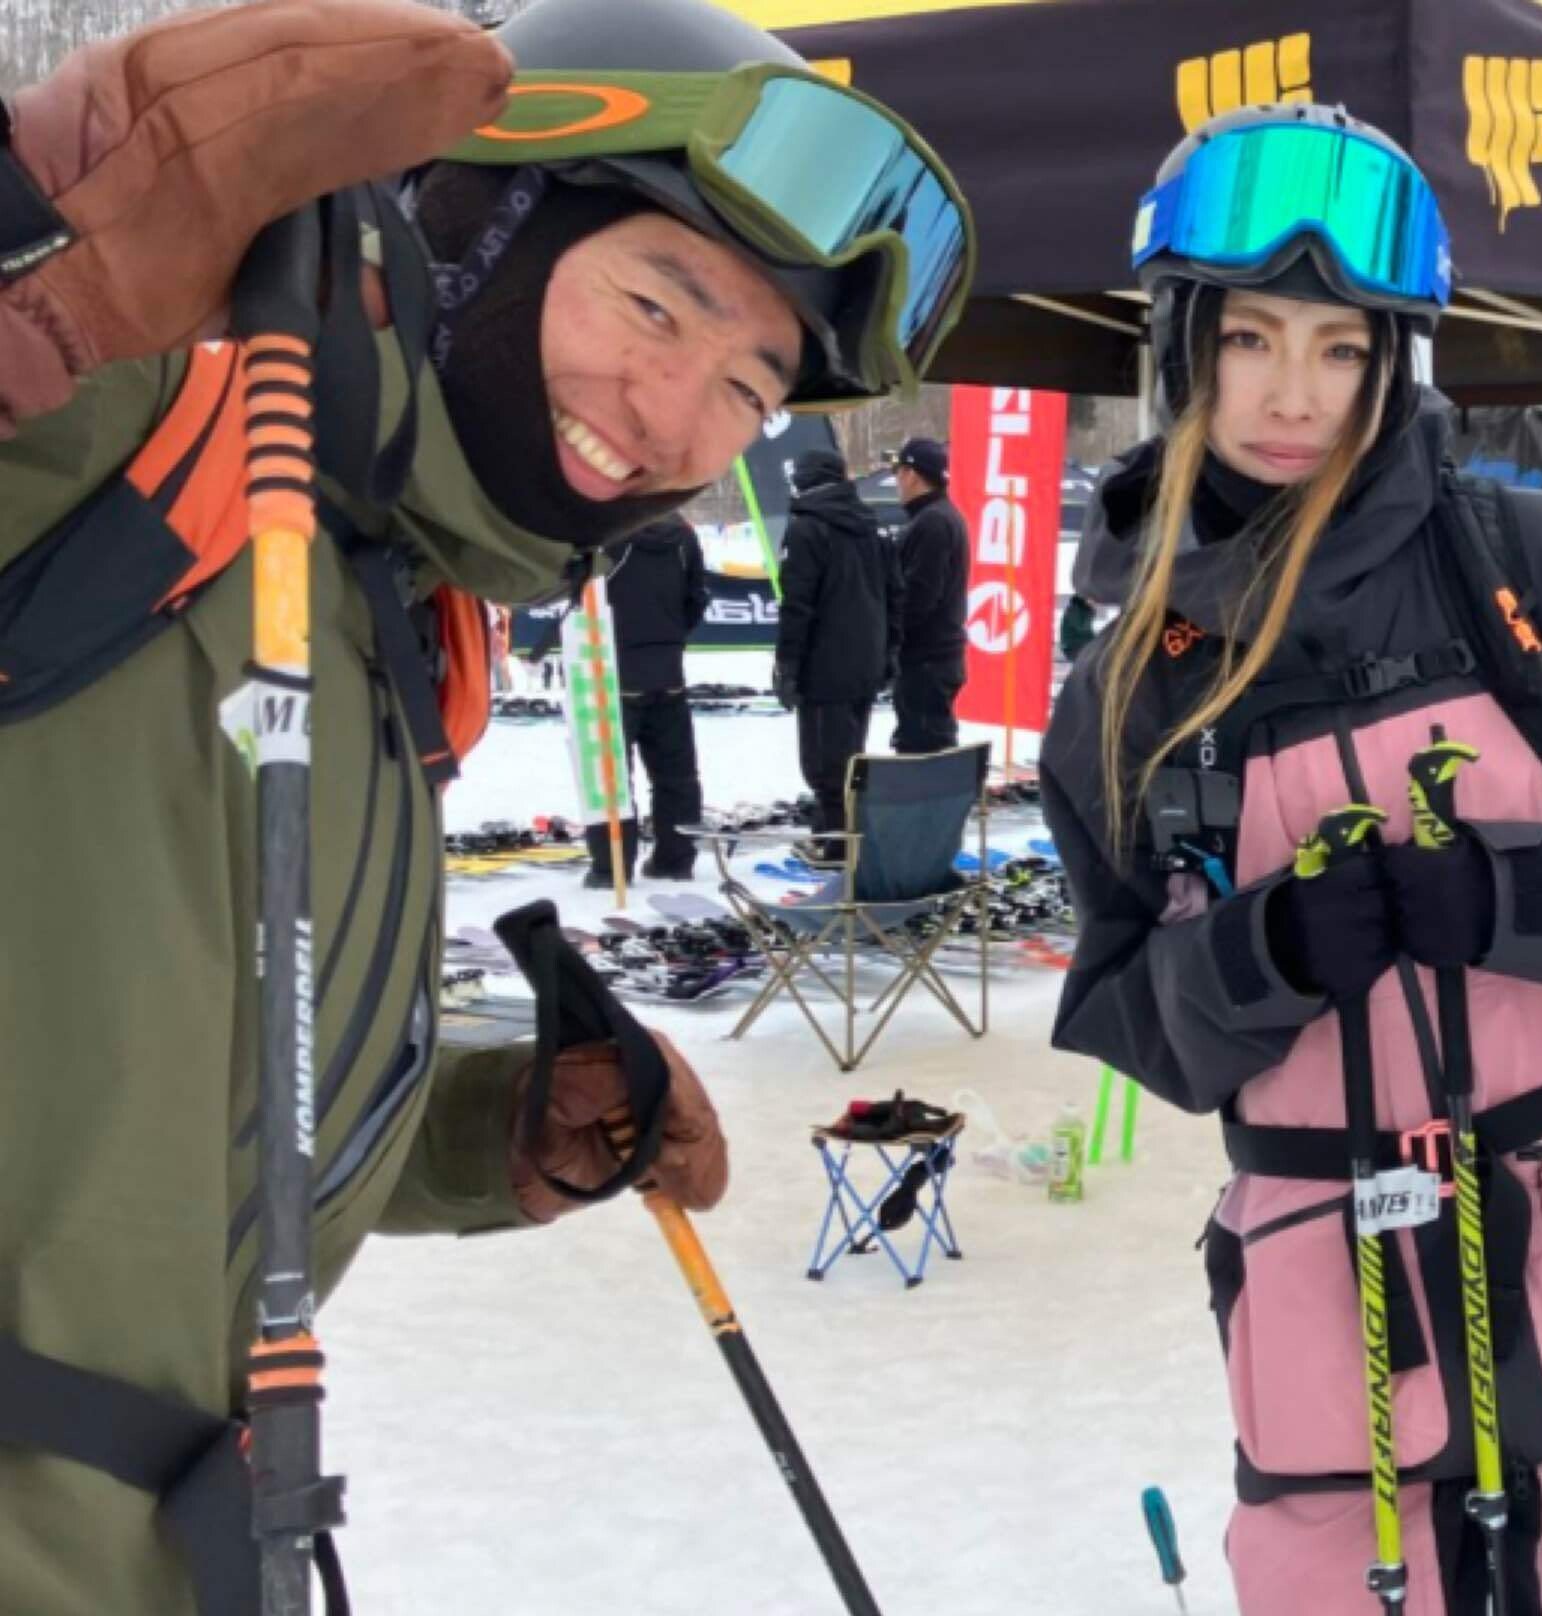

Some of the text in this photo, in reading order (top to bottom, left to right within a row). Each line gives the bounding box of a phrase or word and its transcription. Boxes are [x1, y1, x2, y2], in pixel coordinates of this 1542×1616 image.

[295, 919, 315, 1158] KOMPERDELL
[1363, 1302, 1398, 1511] DYNAFIT
[1459, 1232, 1497, 1441] DYNAFIT
